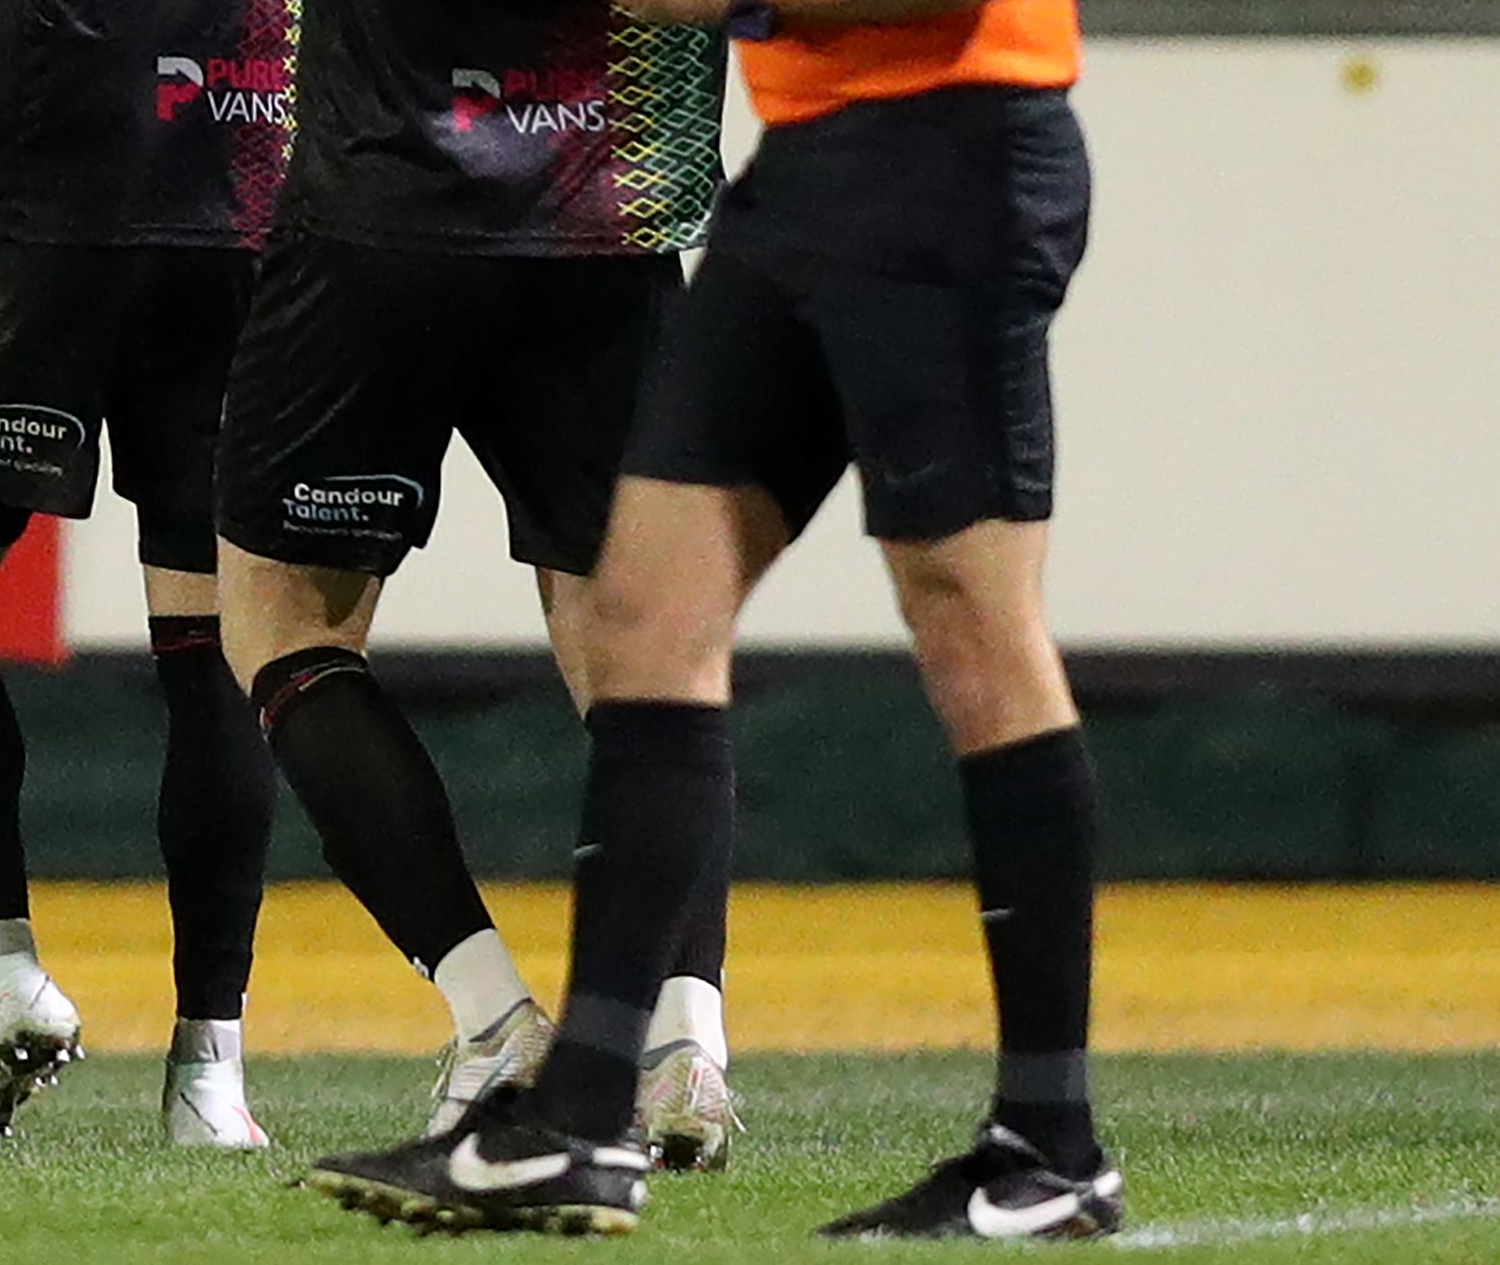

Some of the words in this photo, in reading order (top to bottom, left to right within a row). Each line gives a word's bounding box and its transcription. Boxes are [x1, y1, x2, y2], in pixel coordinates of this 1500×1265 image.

[207, 90, 287, 124] VANS
[506, 100, 606, 134] VANS
[294, 483, 404, 506] Candour
[282, 498, 369, 521] Talent.
